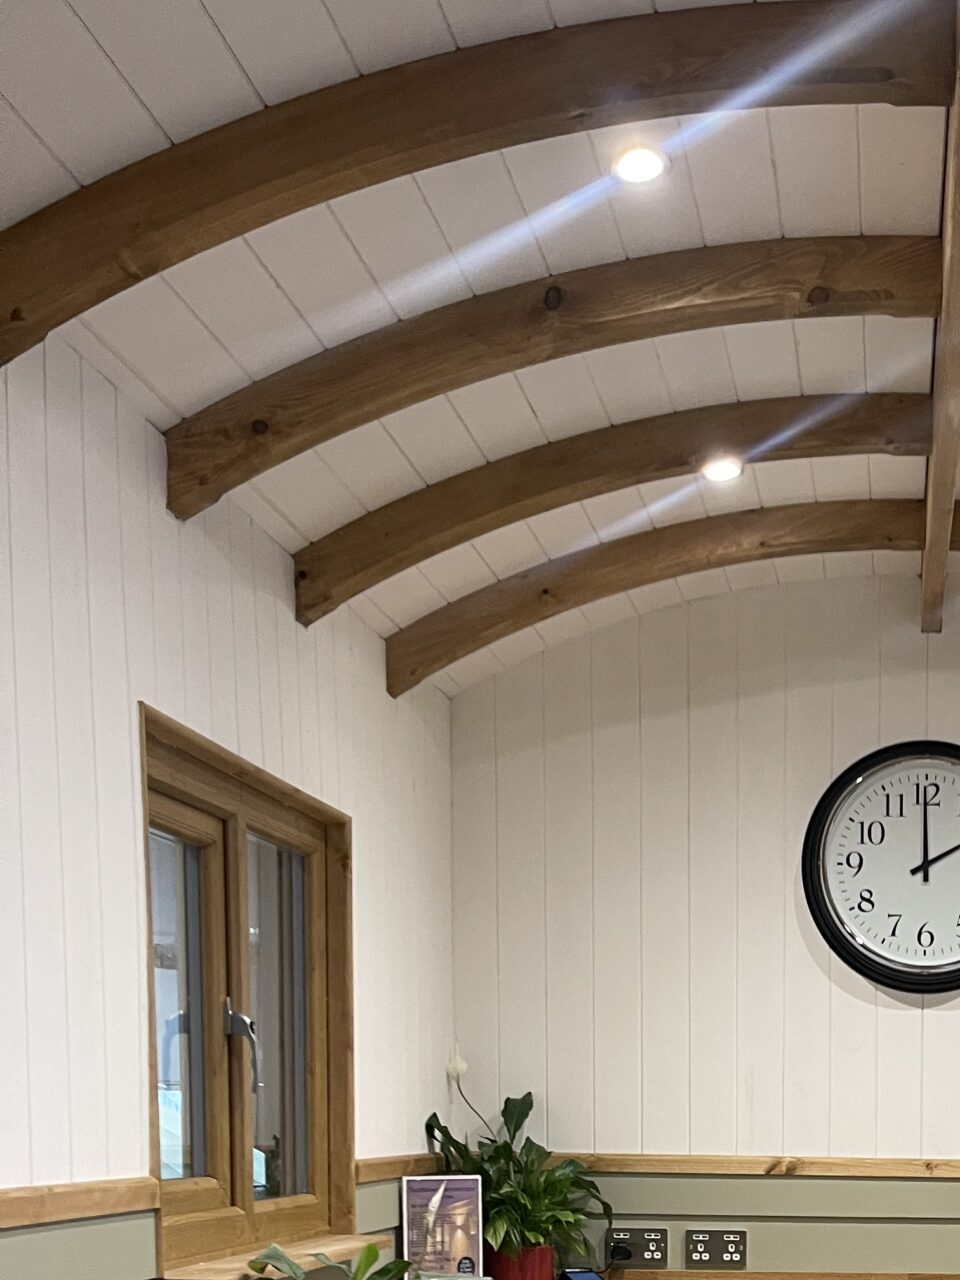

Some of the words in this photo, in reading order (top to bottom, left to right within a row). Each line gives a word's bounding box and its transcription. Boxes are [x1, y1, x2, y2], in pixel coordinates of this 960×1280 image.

[883, 793, 907, 818] 11
[912, 783, 941, 807] 12
[857, 821, 886, 846] 10
[845, 851, 864, 878] 9
[857, 888, 875, 913] 8
[887, 913, 903, 937] 7
[916, 921, 935, 948] 6
